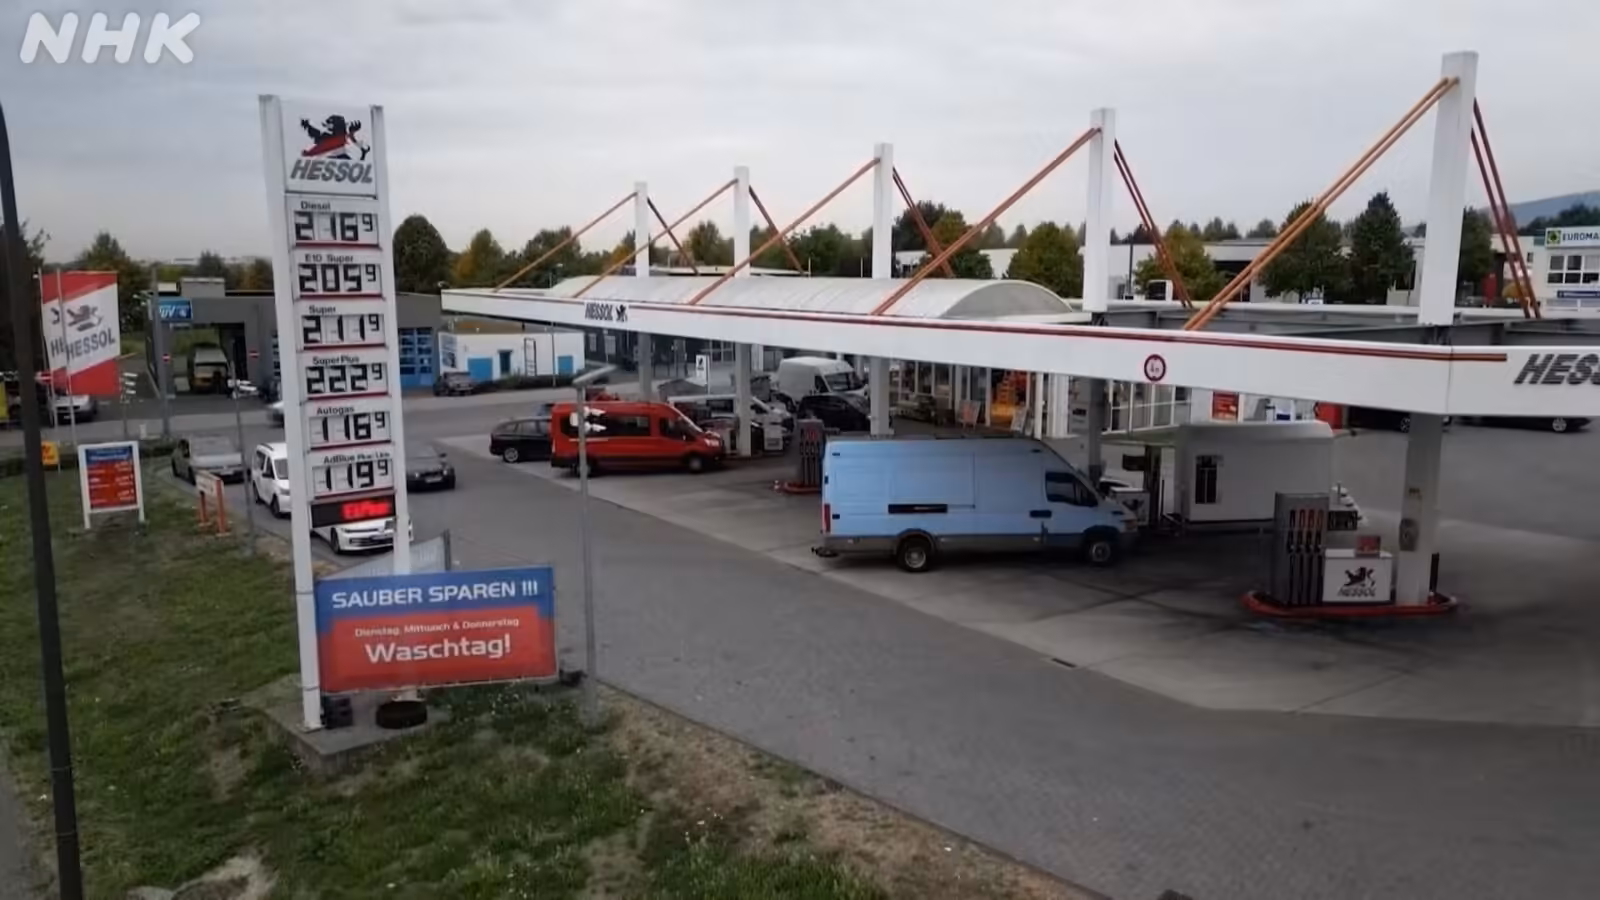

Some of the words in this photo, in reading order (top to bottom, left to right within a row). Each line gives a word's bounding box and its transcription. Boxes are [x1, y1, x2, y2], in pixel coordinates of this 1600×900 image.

[290, 159, 374, 184] HESSOL
[300, 200, 331, 211] Diesel
[304, 253, 323, 263] E10
[326, 254, 354, 266] Super
[308, 304, 337, 316] Super
[584, 302, 613, 321] HESSOL
[66, 328, 117, 363] HESSOL
[1513, 353, 1600, 385] HES
[316, 404, 355, 417] Autogas
[323, 454, 355, 465] AdBlue
[332, 586, 423, 609] SAUBER
[429, 581, 516, 603] SPAREN
[404, 622, 450, 634] Mittwoch
[452, 621, 460, 630] &
[462, 617, 519, 632] Donnerstag
[365, 633, 511, 664] Waschtag!
